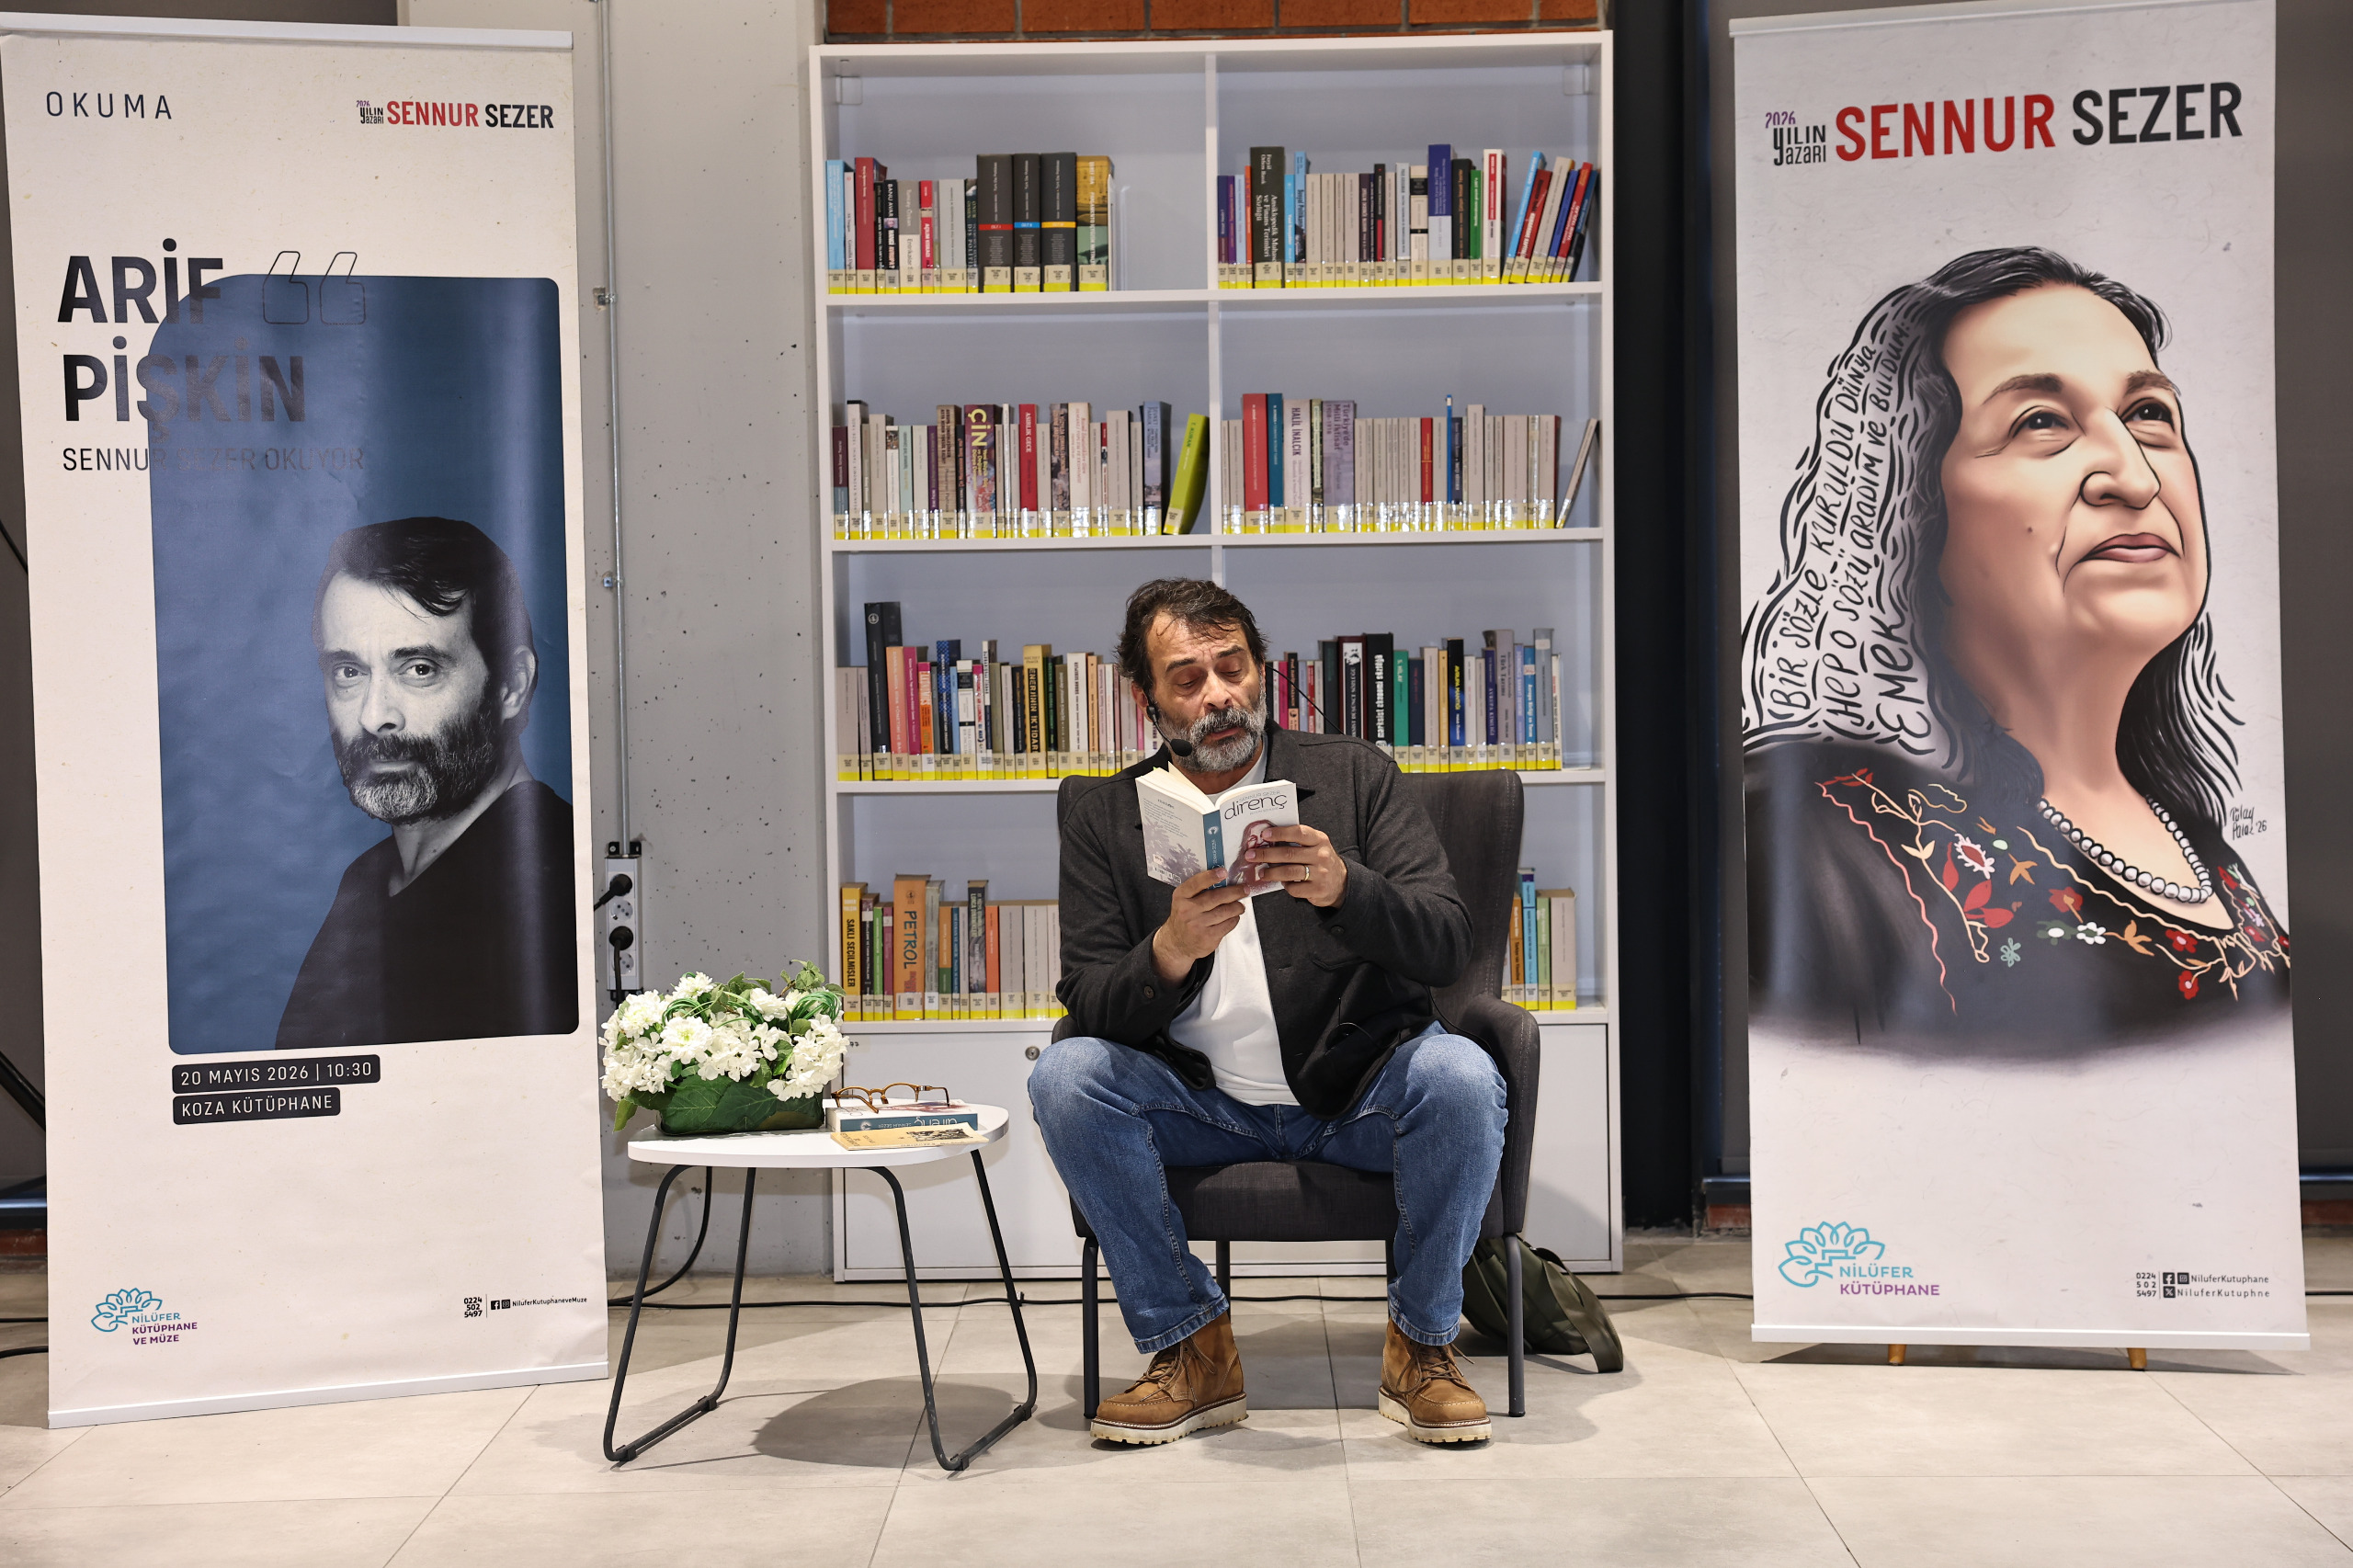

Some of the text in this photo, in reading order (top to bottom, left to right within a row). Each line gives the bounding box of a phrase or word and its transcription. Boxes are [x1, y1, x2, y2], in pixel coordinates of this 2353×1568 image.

[46, 91, 173, 119] OKUMA
[387, 101, 479, 127] SENNUR
[485, 104, 554, 129] SEZER
[1765, 111, 1796, 128] 2026
[1836, 94, 2055, 162] SENNUR
[2073, 82, 2243, 146] SEZER
[57, 238, 223, 324] ARİF
[63, 335, 305, 442] PİŞKİN
[968, 409, 991, 447] ÇİN
[1291, 407, 1303, 456] HALİL İNALCIK
[63, 448, 364, 471] SENNUR SEZER OKUYOR
[1811, 419, 1854, 556] KURULDU
[1029, 669, 1037, 711] ENERJİNİN
[1224, 794, 1288, 821] direnç
[904, 911, 917, 969] PETROL
[847, 919, 856, 987] SAKLI SEÇİLMİŞLER
[181, 1062, 371, 1085] 20 MAYIS 2026 10:30
[182, 1095, 333, 1117] KOZA KÜTÜPHANE
[1839, 1260, 1915, 1279] NİLÜFER
[2191, 1274, 2269, 1284] NiluferKutuphane
[1839, 1279, 1940, 1296] KÜTÜPHANE
[2177, 1289, 2269, 1298] NiluferKutuphne
[512, 1297, 587, 1307] NiluferKutuphaneveMuze
[132, 1312, 181, 1324] NİLÜFER
[464, 1310, 483, 1318] 5497
[132, 1322, 198, 1335] KÜTÜPHANE
[150, 1334, 179, 1344] MÜZE
